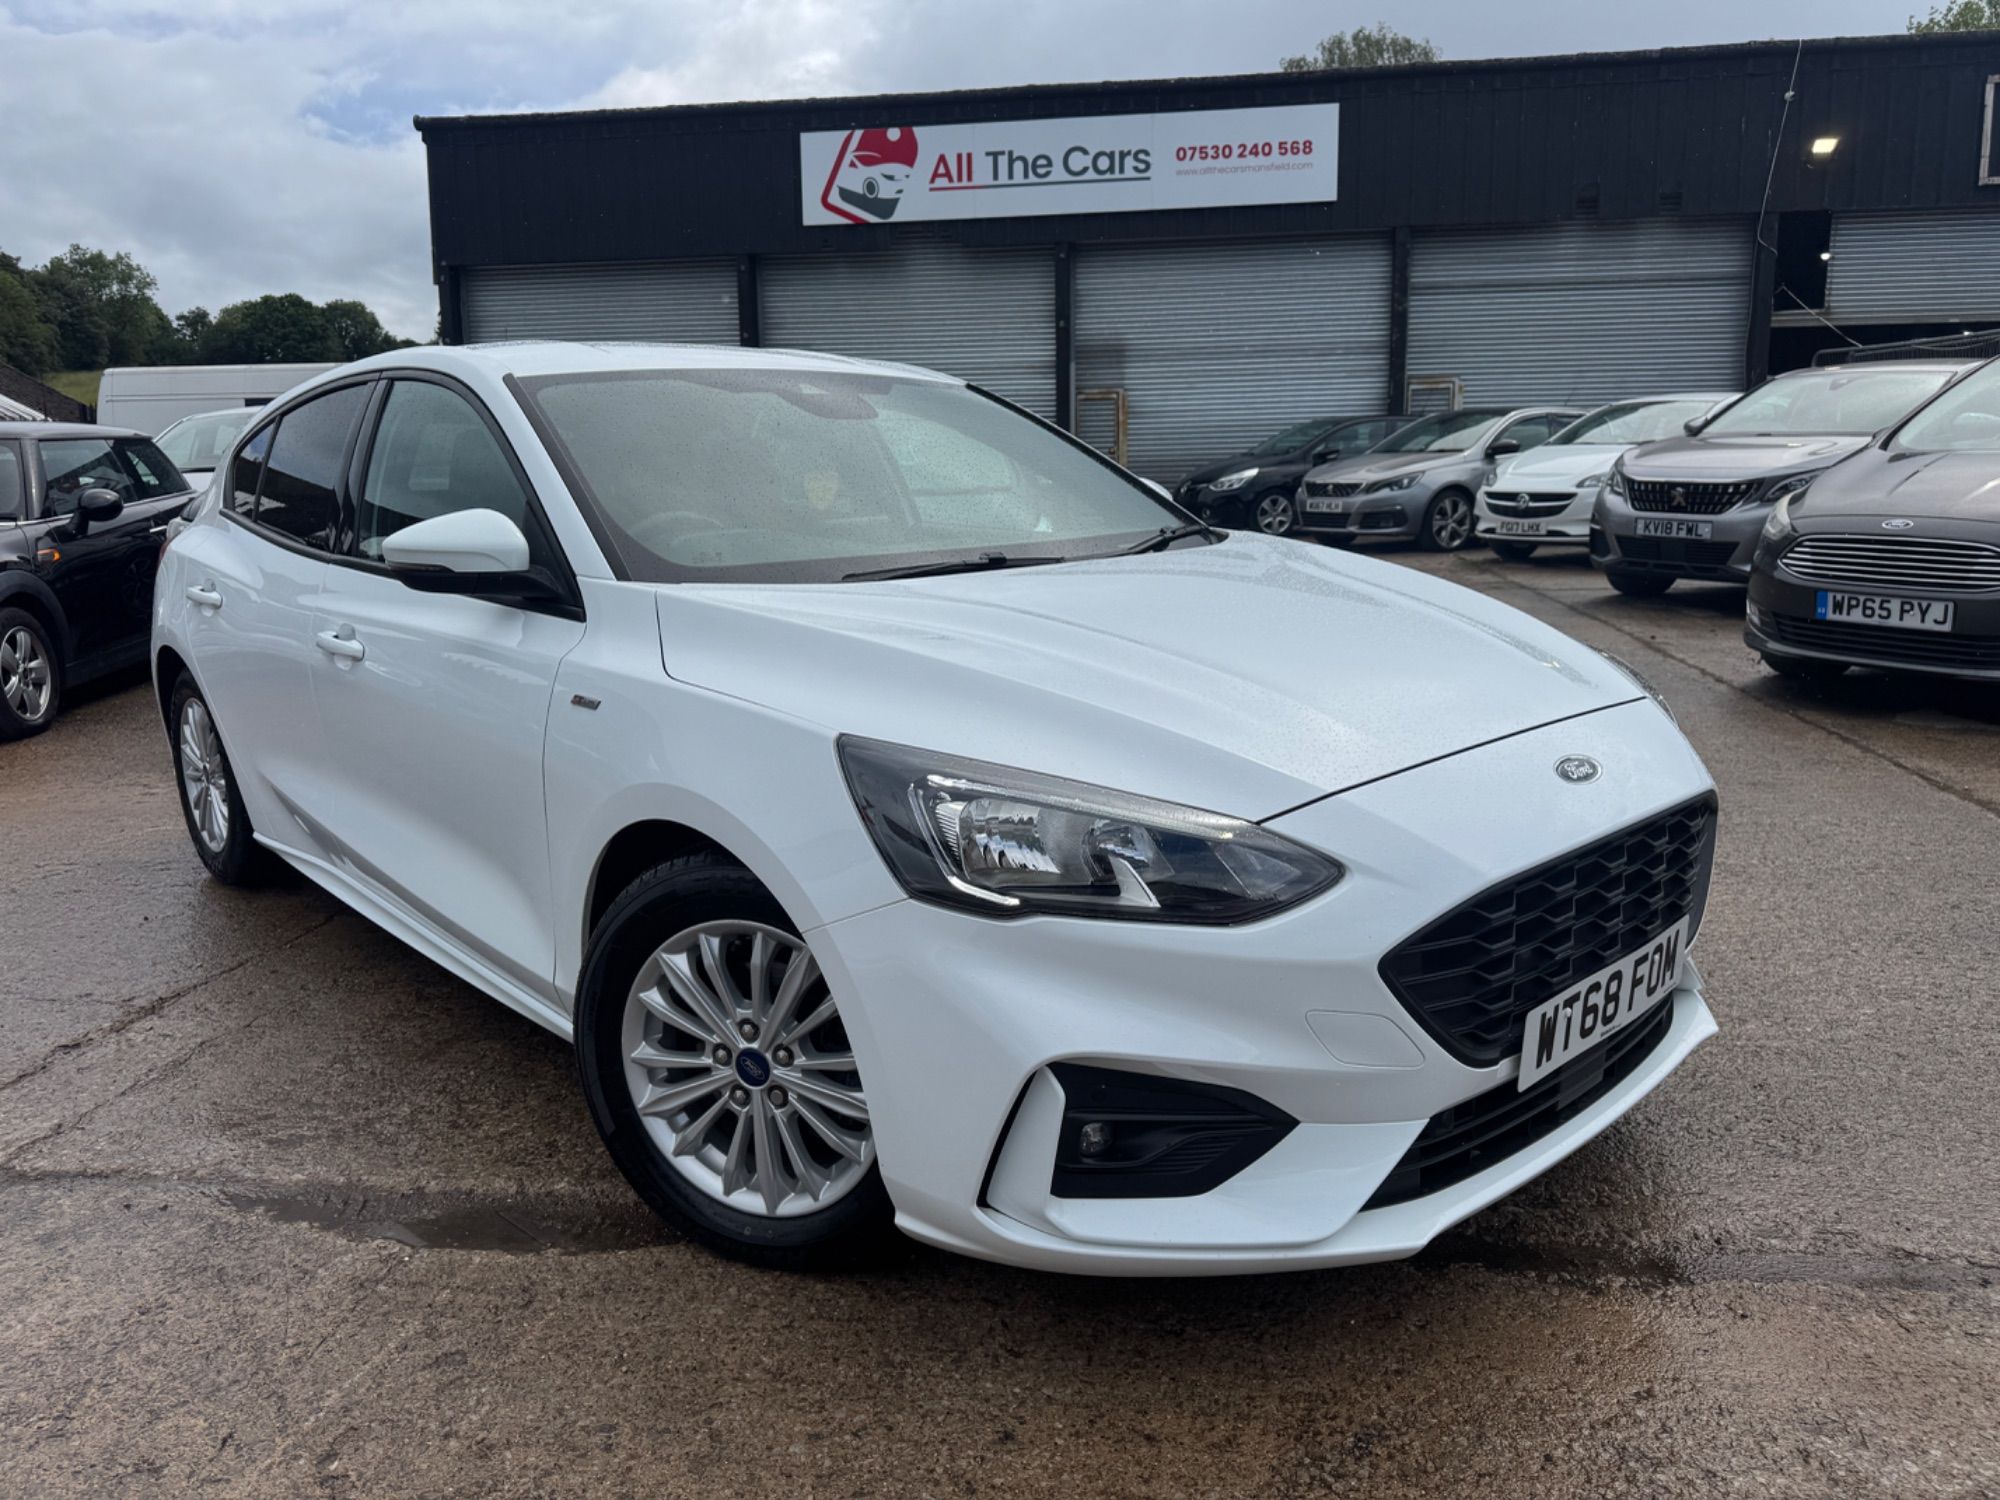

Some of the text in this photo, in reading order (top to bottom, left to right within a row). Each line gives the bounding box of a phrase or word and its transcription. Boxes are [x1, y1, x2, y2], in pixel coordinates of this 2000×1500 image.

[1175, 139, 1313, 162] 07530 240 568
[929, 145, 1152, 184] All The Cars
[1175, 161, 1313, 177] www.allthecarsmansfield.com
[1643, 519, 1703, 537] KV18 FWL
[1831, 593, 1949, 625] WP65 PYJ
[1536, 929, 1680, 1070] WT68 FOM
